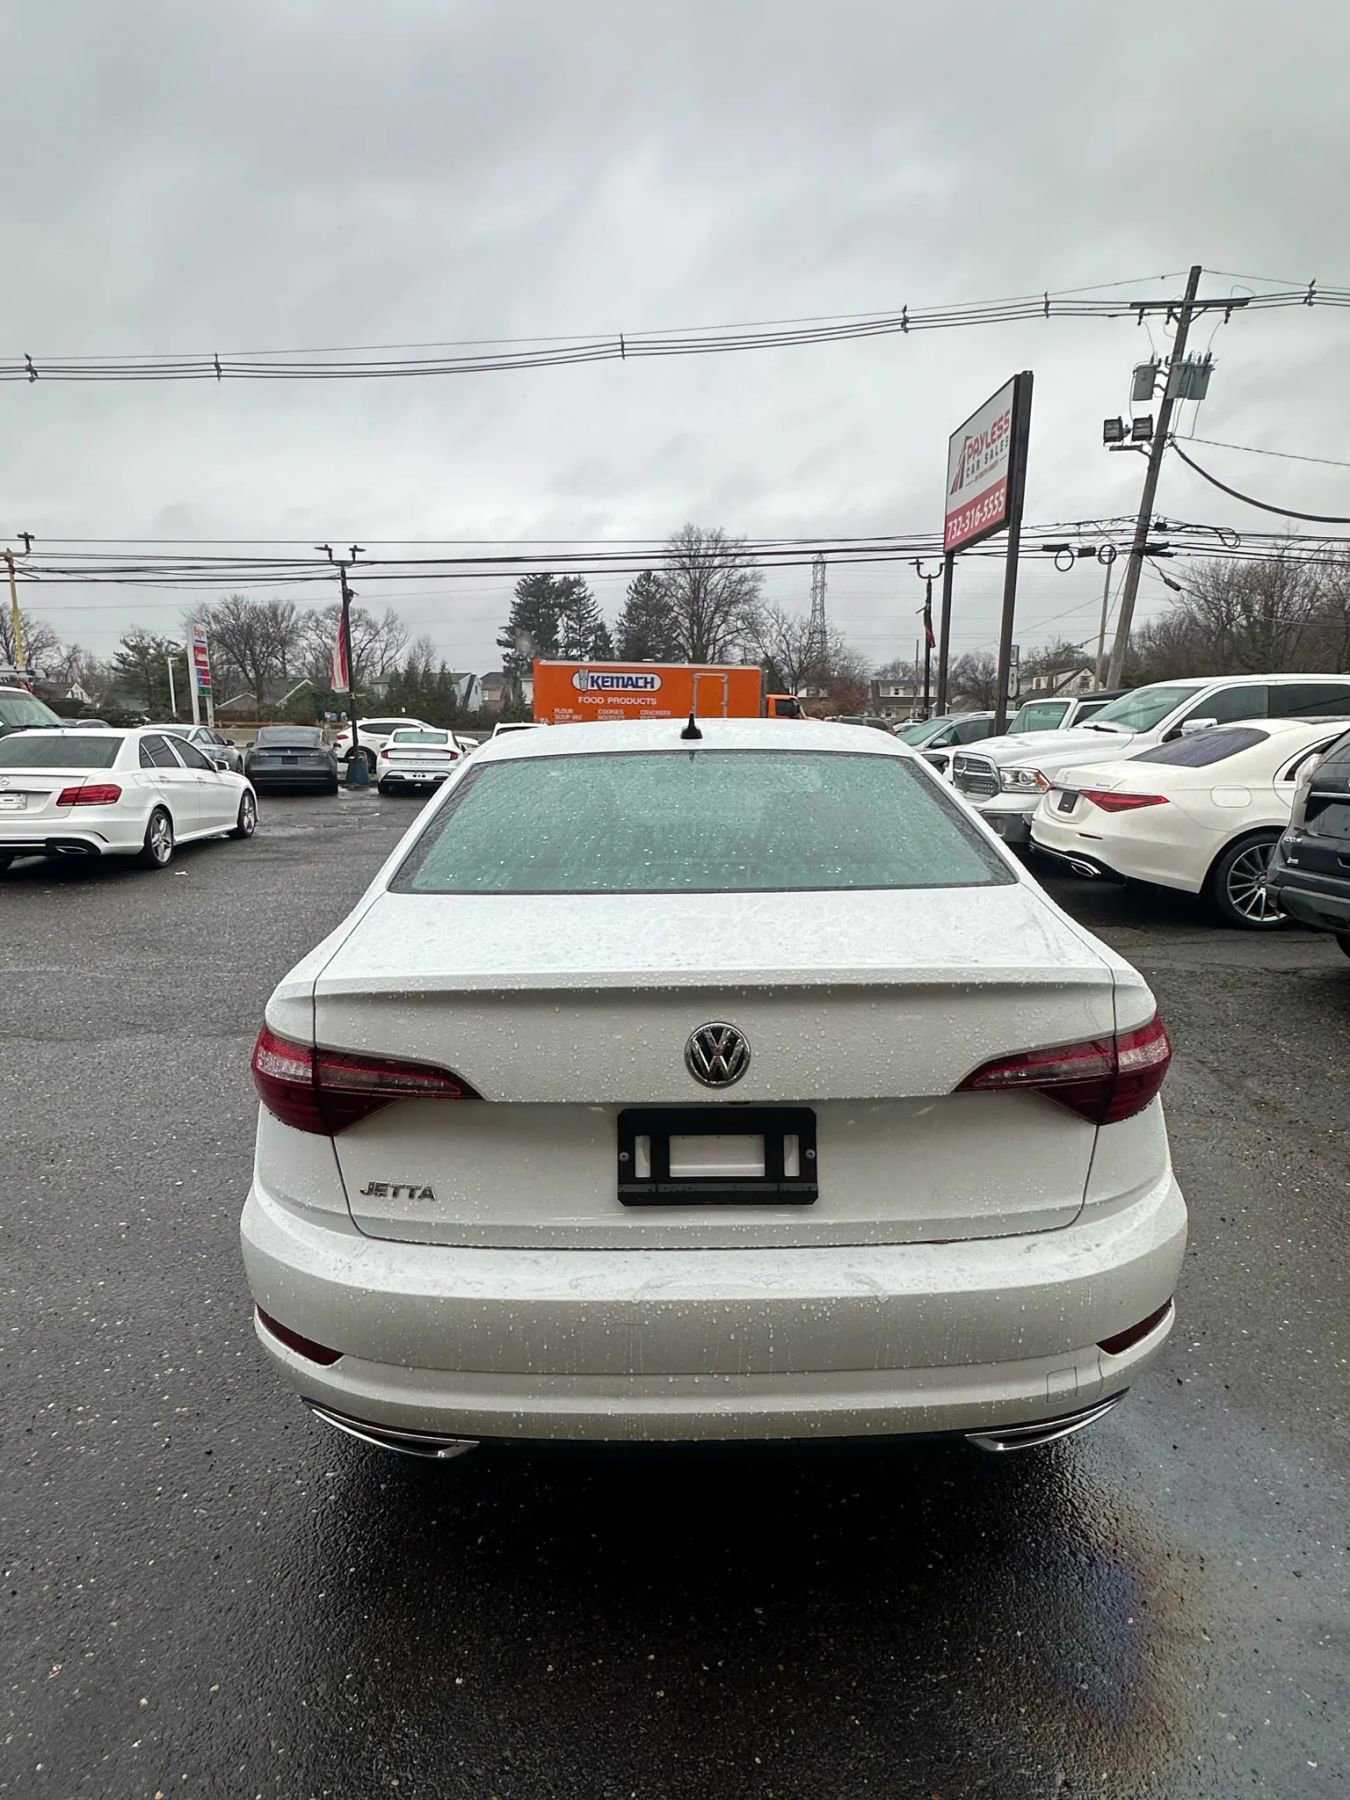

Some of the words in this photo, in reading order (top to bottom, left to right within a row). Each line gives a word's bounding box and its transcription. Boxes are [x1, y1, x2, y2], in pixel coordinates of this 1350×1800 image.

[967, 407, 1010, 464] PAYLESS
[966, 458, 980, 479] CAR
[984, 434, 1009, 465] SALES
[947, 487, 1005, 542] 732-316-5555
[590, 675, 655, 690] KEMACH
[578, 696, 604, 704] FOOD
[607, 697, 657, 705] PRODUCTS
[359, 1180, 437, 1202] JETTA
